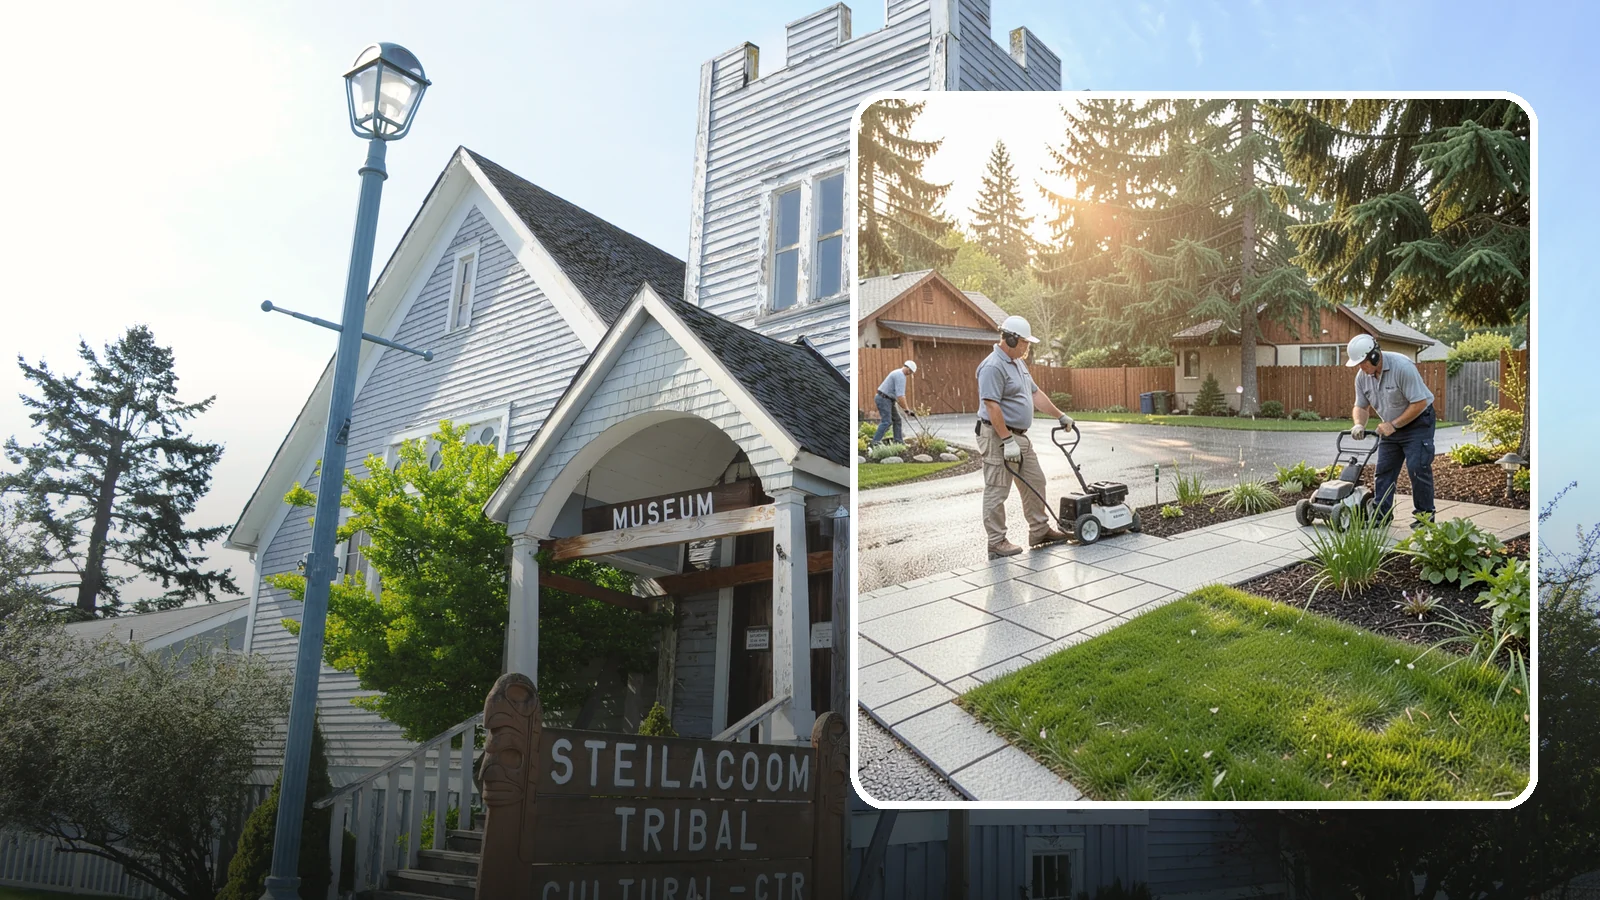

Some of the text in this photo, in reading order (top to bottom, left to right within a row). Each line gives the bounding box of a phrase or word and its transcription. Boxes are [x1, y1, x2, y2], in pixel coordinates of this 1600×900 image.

[613, 492, 714, 530] MUSEUM
[550, 738, 809, 792] STEILACOOM
[614, 807, 757, 852] TRIBAL
